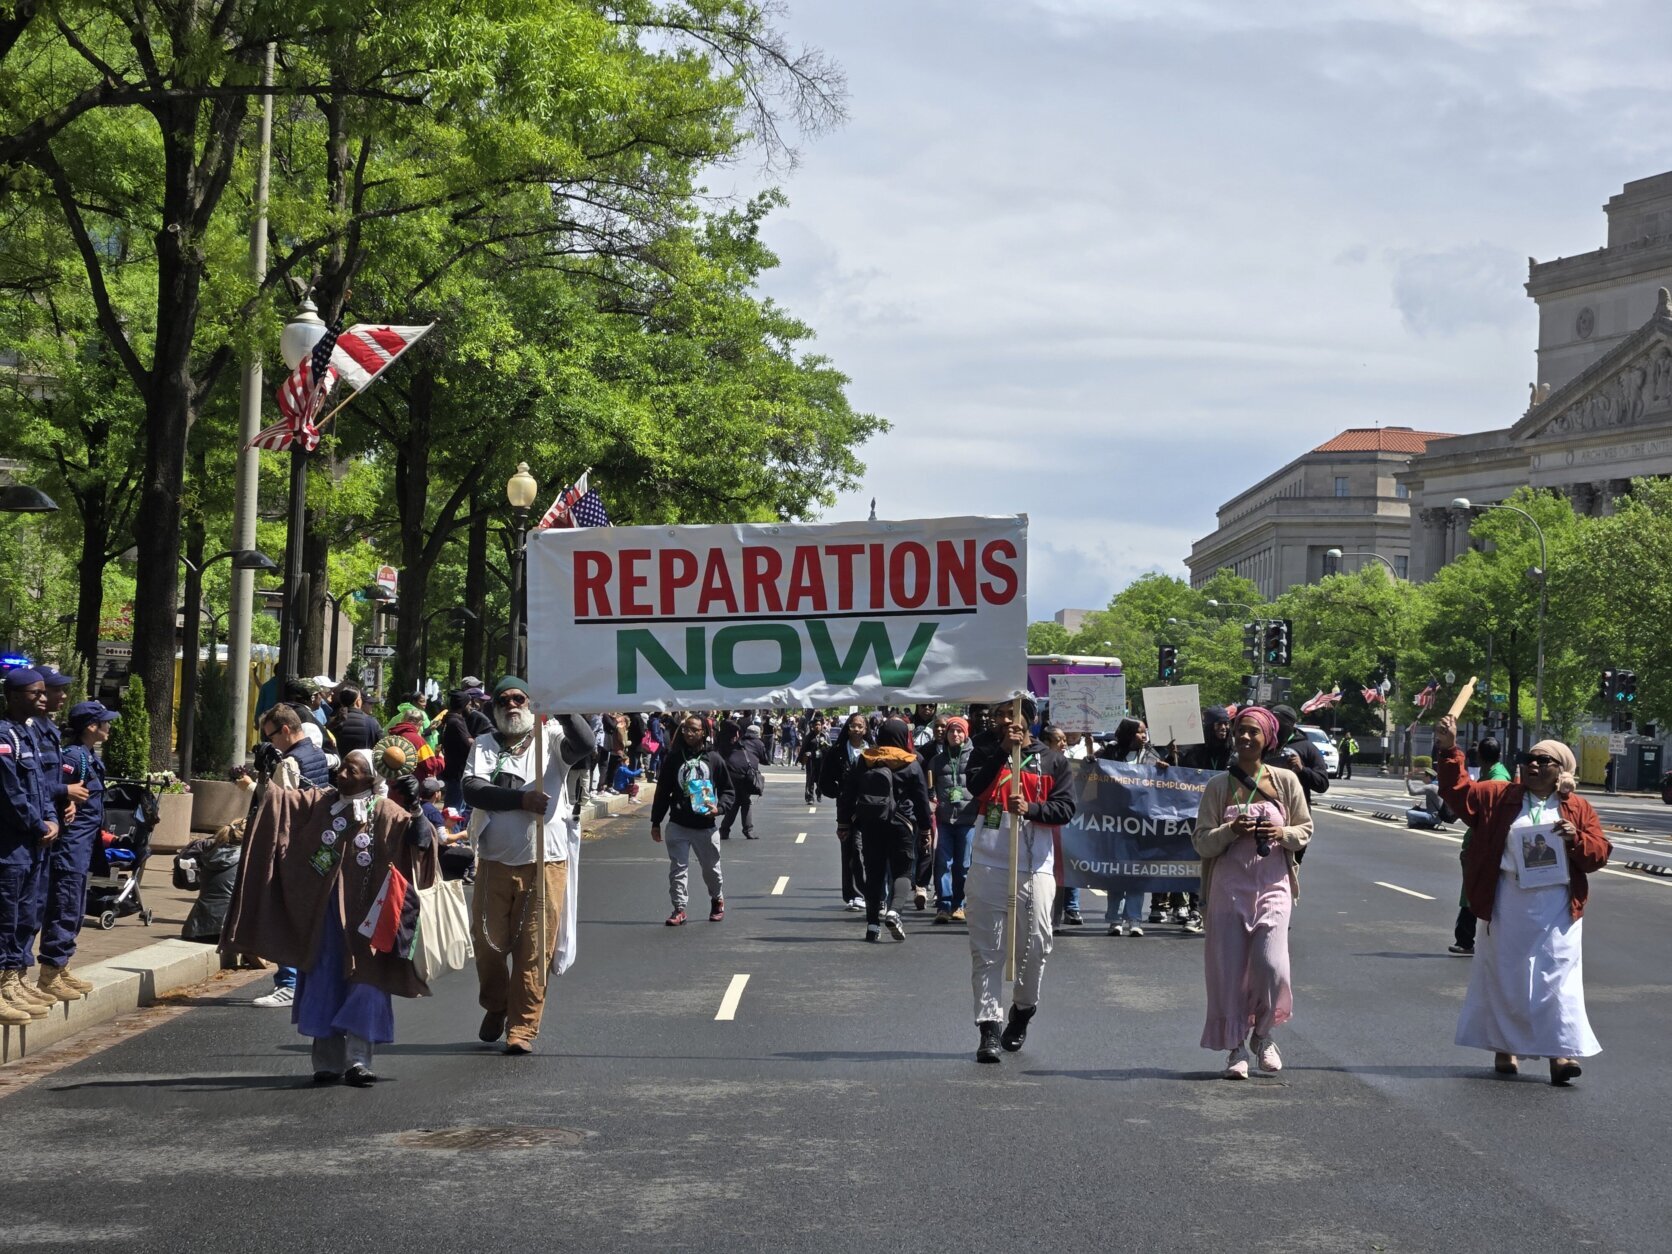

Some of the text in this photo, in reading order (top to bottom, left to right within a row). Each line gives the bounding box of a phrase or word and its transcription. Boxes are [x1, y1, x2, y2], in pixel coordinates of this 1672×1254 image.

[1581, 447, 1617, 461] ARCHIVES
[1631, 443, 1645, 456] THE
[1646, 439, 1672, 455] UNITE
[573, 539, 1018, 616] REPARATIONS
[617, 620, 939, 694] NOW
[1141, 779, 1155, 787] OF
[1156, 780, 1206, 793] EMPLOYME
[1065, 813, 1193, 836] MARION BA
[1070, 859, 1201, 876] YOUTH LEADERSHI
